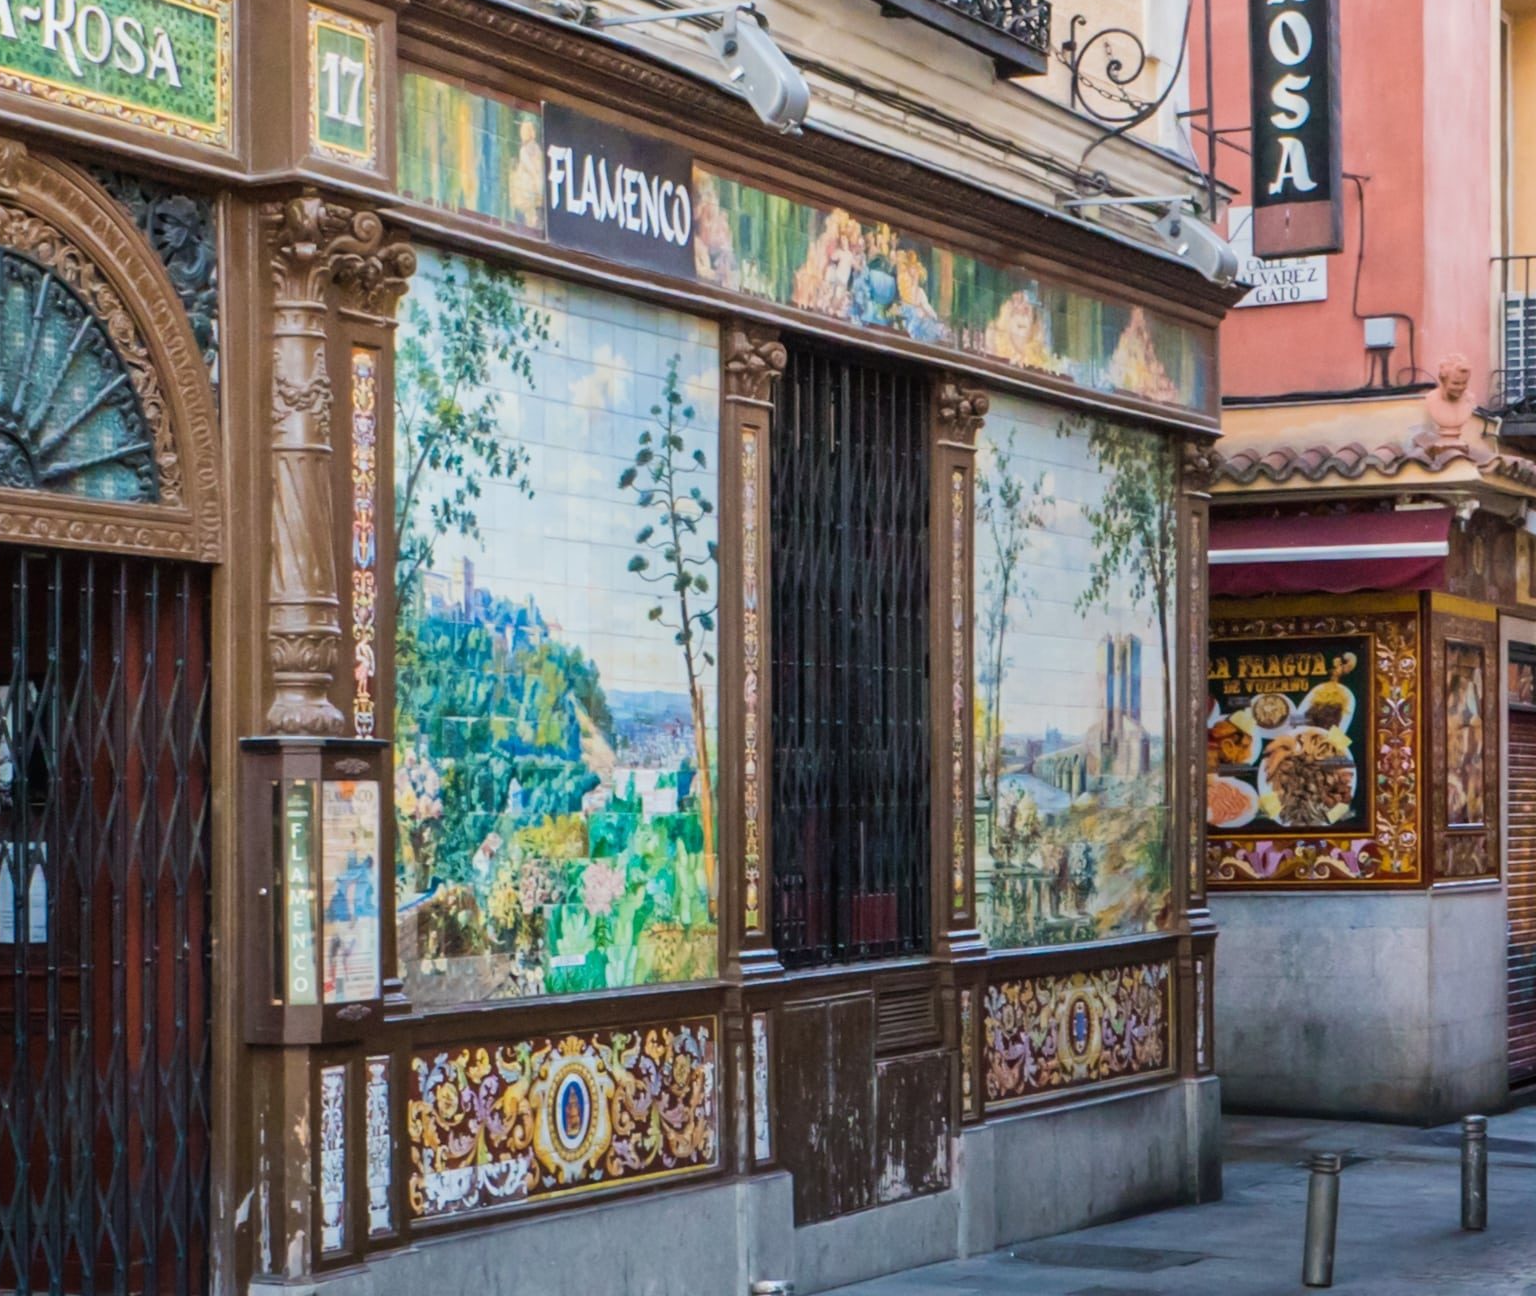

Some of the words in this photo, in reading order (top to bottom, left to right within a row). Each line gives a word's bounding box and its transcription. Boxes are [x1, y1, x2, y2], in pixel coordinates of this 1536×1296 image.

[320, 51, 366, 129] 17
[547, 143, 692, 248] FLAMENCO
[1255, 286, 1301, 303] GATO
[1237, 652, 1328, 678] FRAGUA
[290, 822, 308, 993] FLAMENCO
